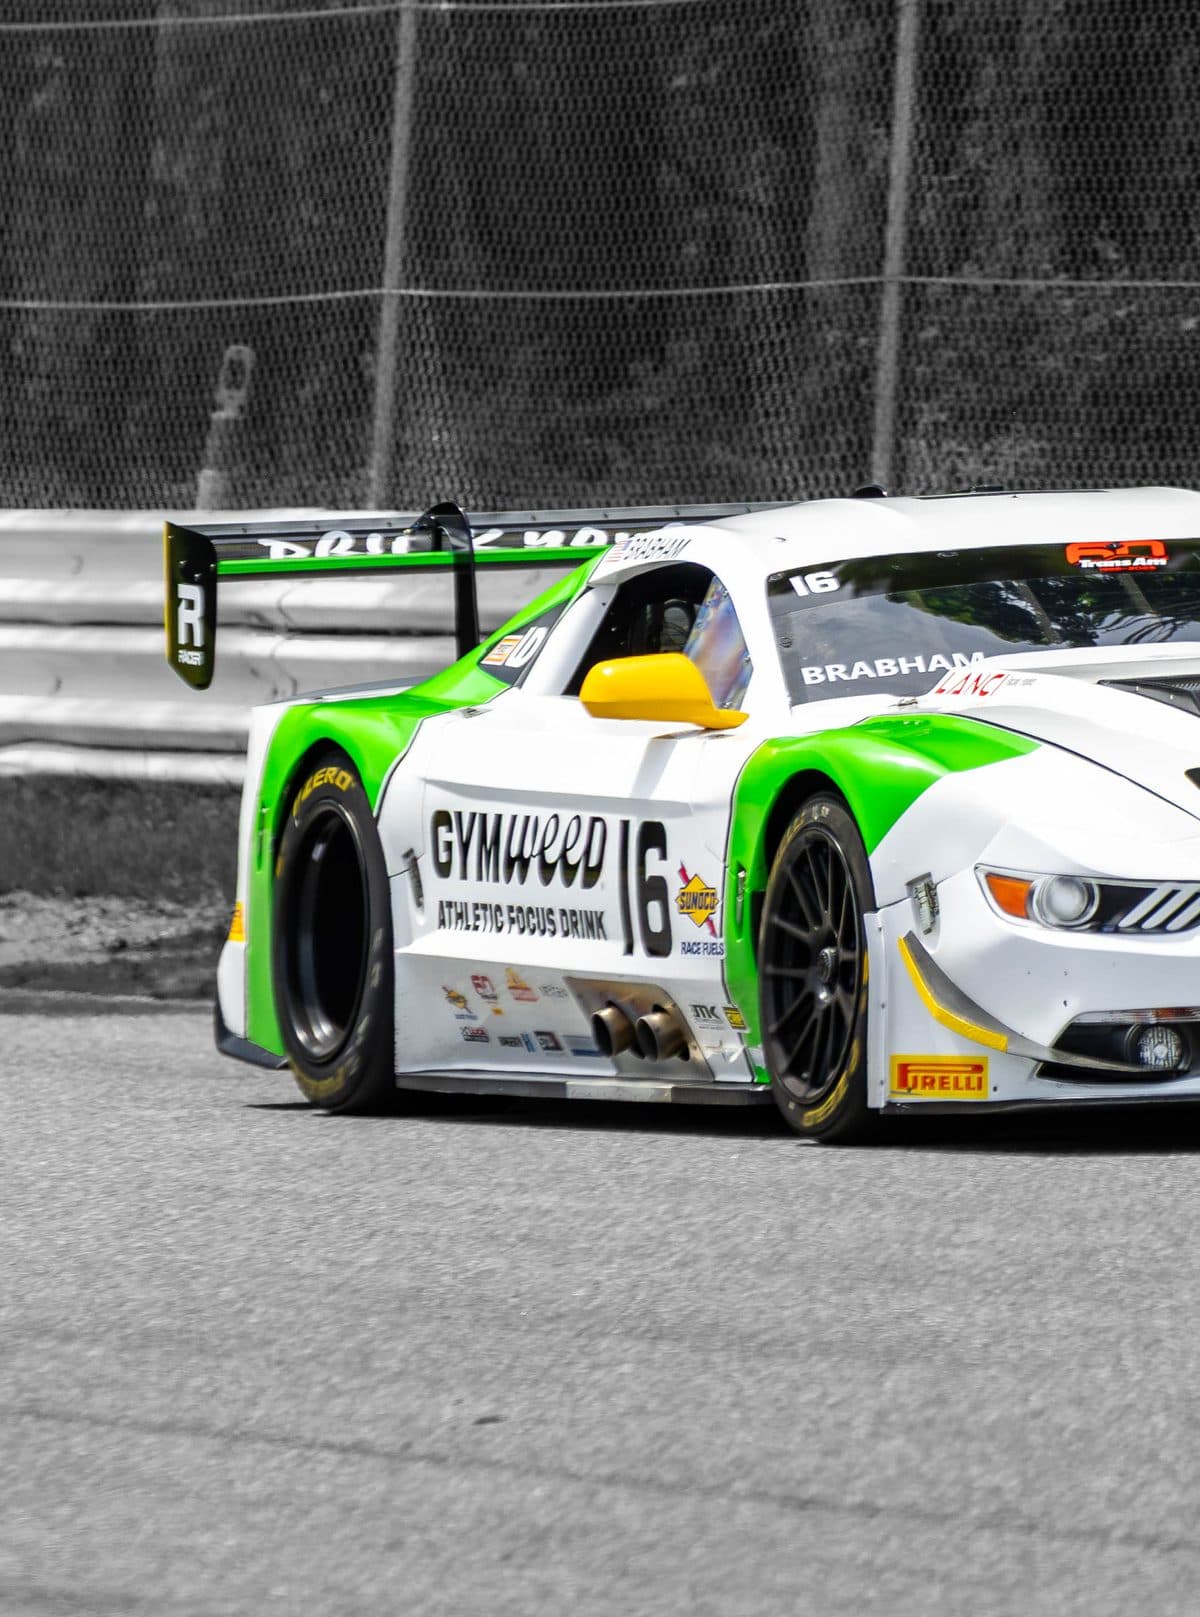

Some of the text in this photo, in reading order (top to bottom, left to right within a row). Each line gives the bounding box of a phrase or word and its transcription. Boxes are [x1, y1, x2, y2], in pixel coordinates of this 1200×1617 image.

[788, 570, 840, 597] 16
[177, 583, 205, 648] R
[800, 650, 985, 686] BRABHAM
[620, 818, 673, 958] 16
[679, 891, 718, 911] SUNOCO
[437, 900, 609, 941] ATHLETIC FOCUS DRINK
[680, 941, 725, 957] RACE FUELS
[896, 1062, 984, 1092] PIRELLI
